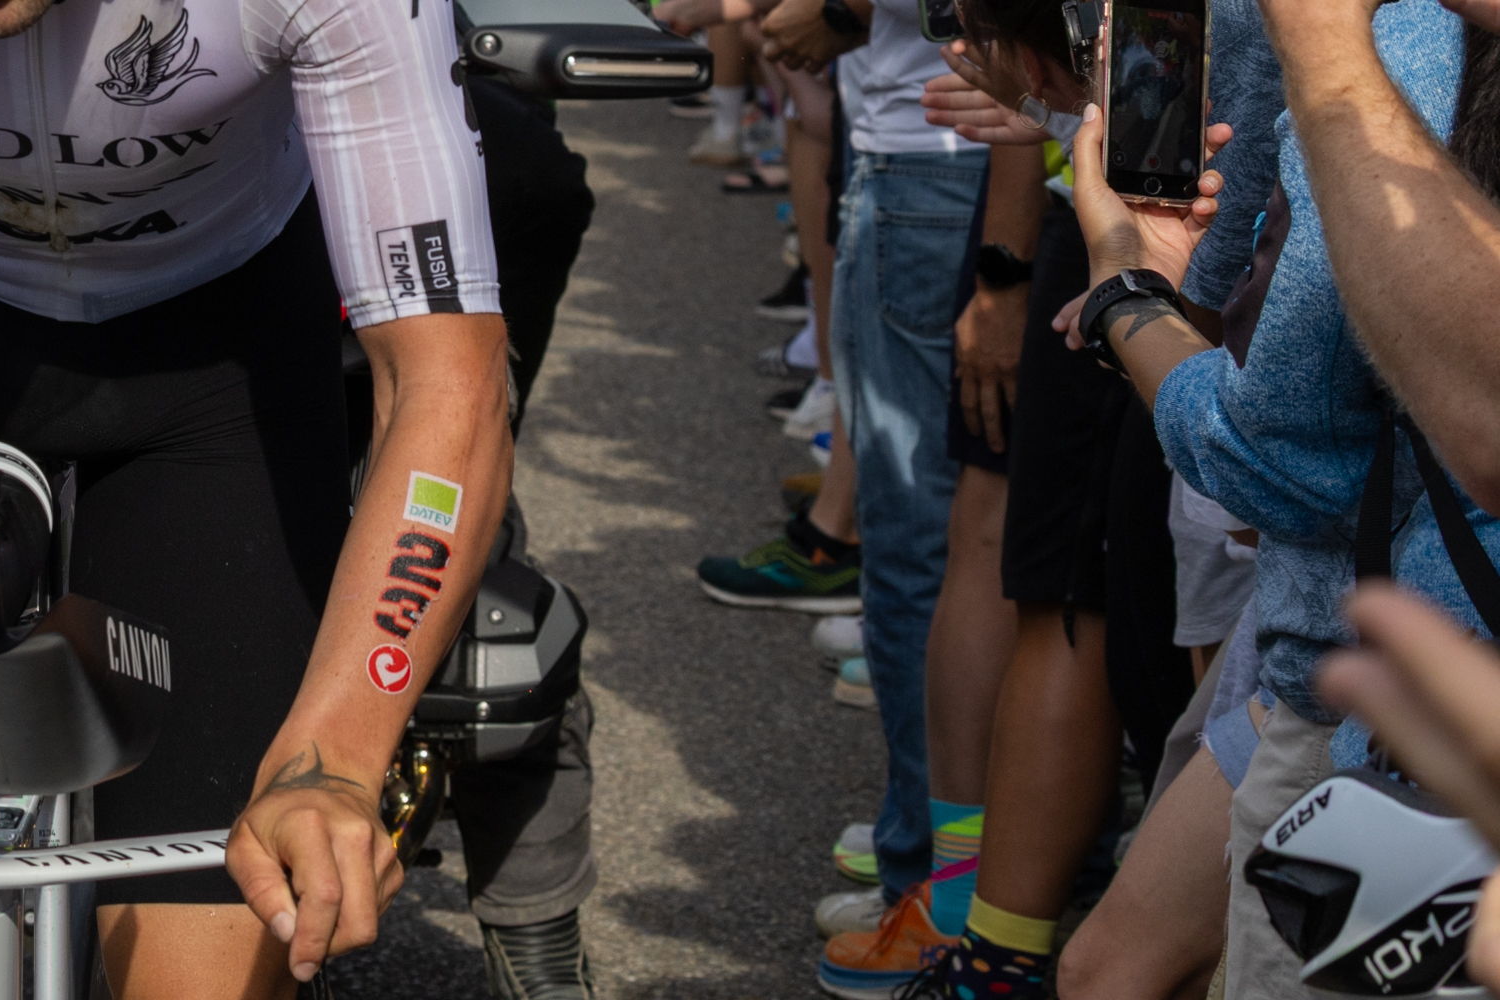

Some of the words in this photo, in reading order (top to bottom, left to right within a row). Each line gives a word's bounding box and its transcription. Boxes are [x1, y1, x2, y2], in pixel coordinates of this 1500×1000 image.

[51, 116, 234, 168] LOW
[408, 504, 454, 527] DATEV
[373, 531, 452, 641] 23
[106, 615, 172, 693] CANYON
[1274, 787, 1332, 847] AR13
